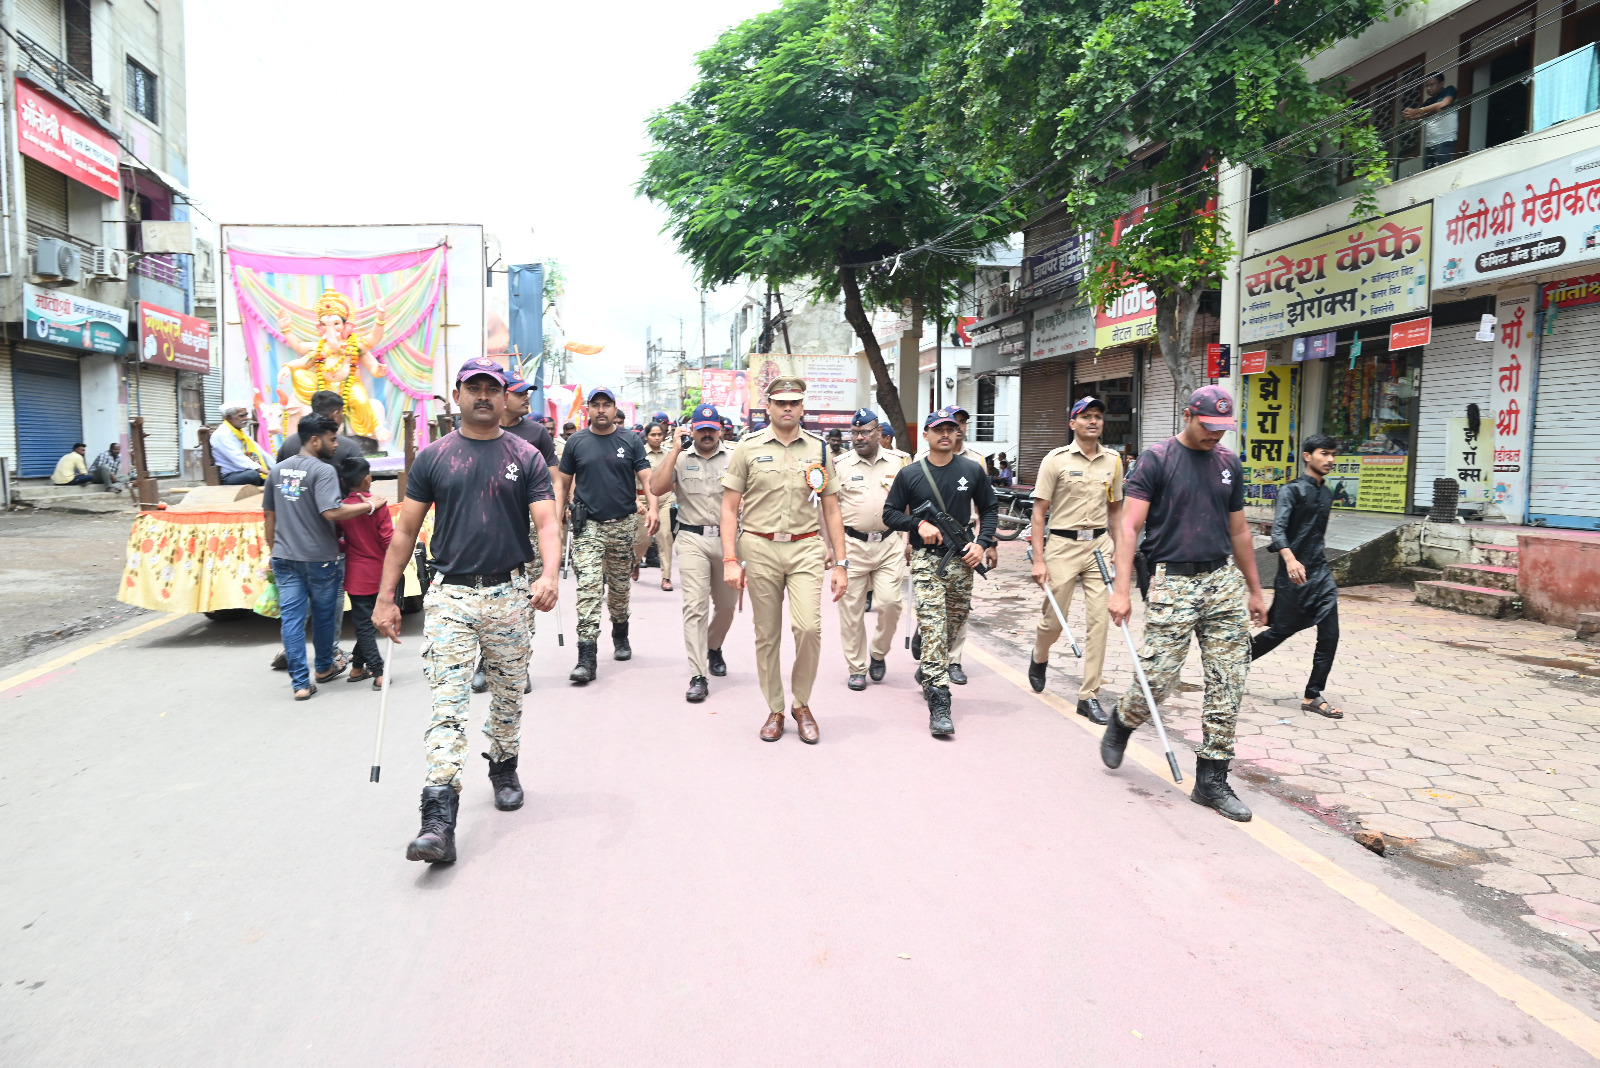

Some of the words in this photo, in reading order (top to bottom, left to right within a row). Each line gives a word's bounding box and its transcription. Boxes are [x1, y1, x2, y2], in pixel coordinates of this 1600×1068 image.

[1244, 253, 1328, 298] संदेश
[1334, 221, 1424, 272] कॅफे
[1286, 286, 1359, 328] झेरॉक्स
[1250, 370, 1284, 462] झेरॉक्स
